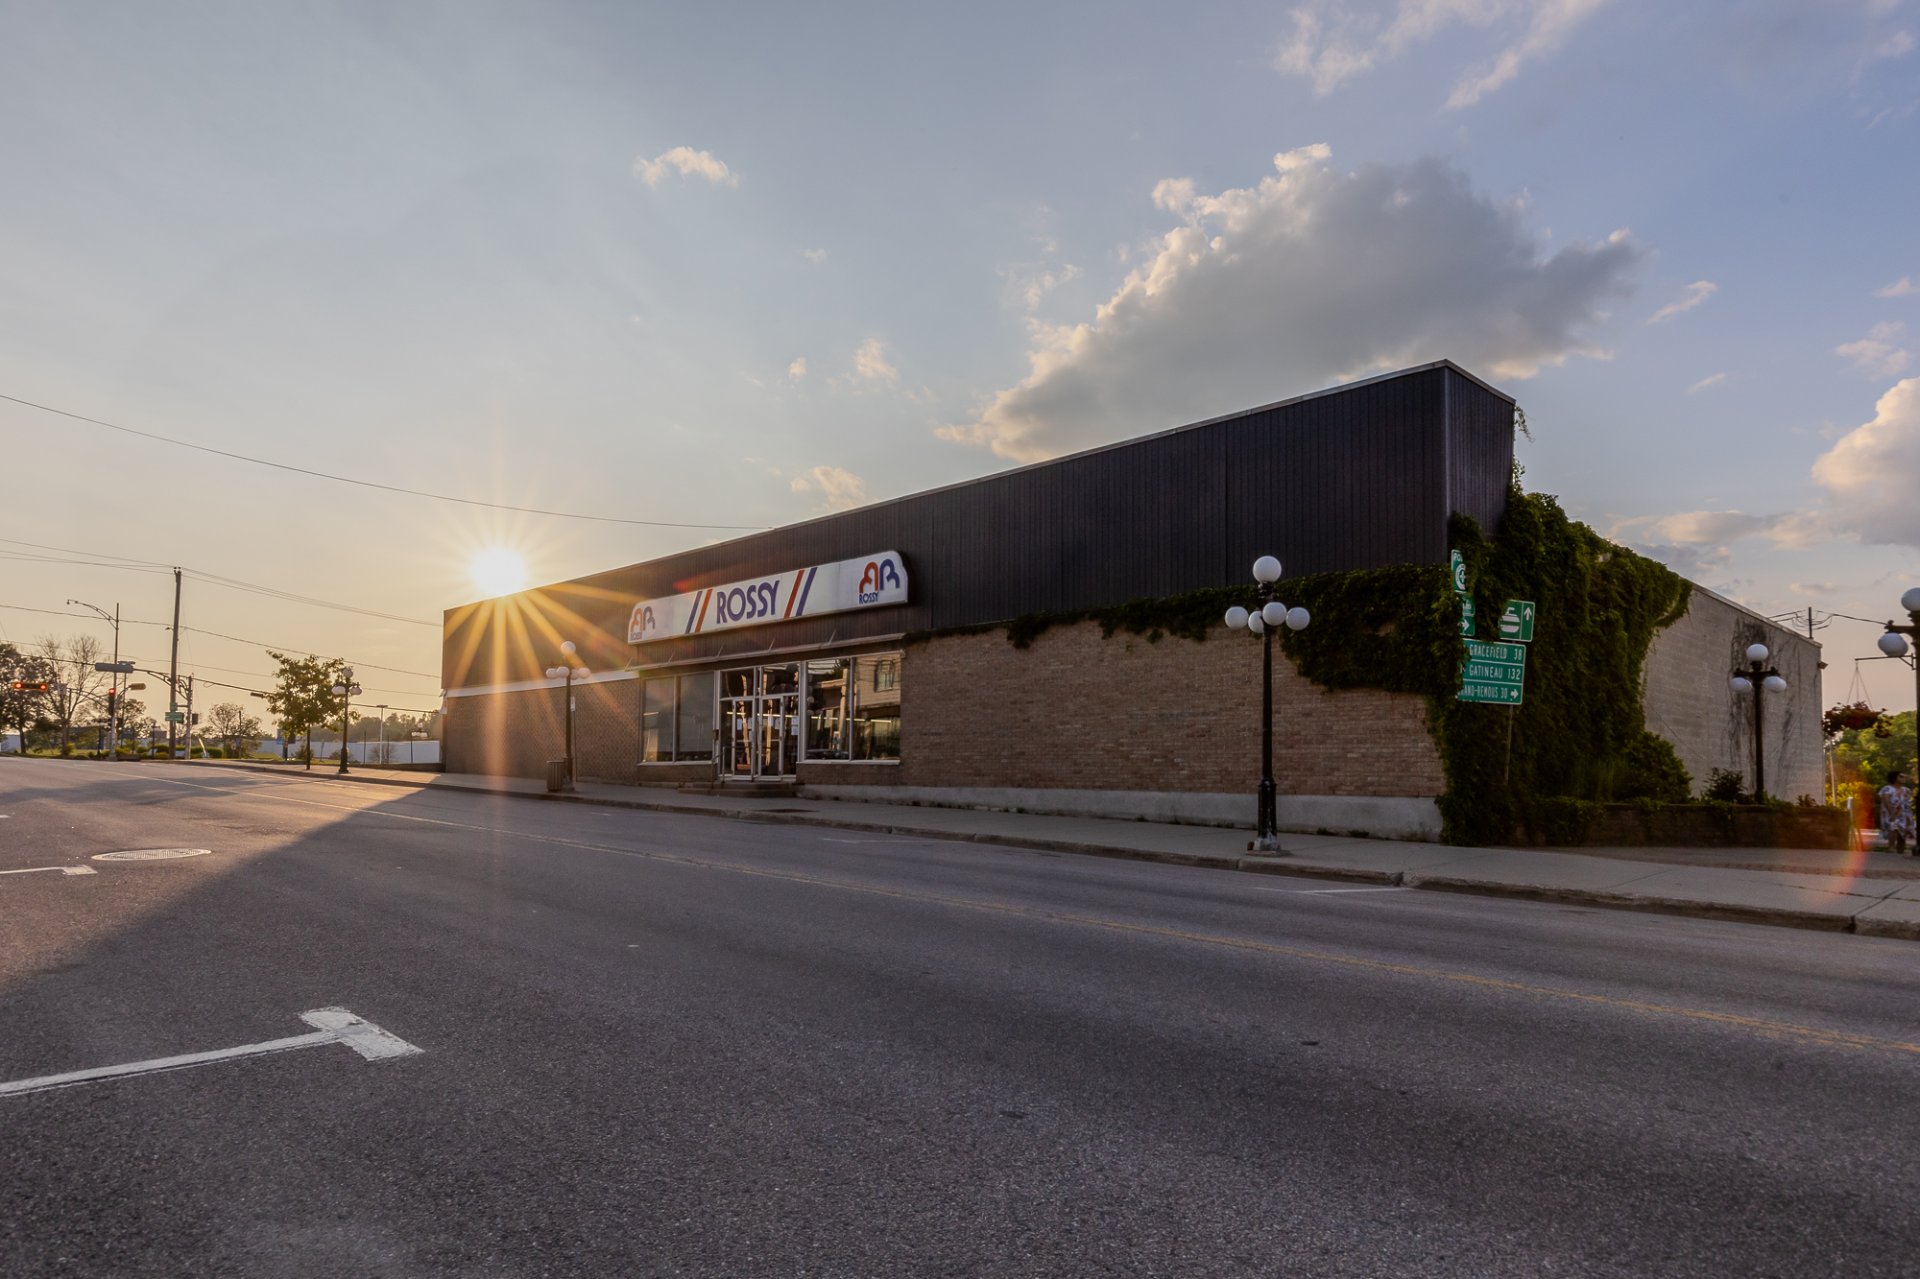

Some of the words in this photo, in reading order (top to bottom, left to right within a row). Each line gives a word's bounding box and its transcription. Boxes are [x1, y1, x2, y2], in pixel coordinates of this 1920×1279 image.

[716, 580, 780, 624] ROSSY
[858, 592, 879, 604] ROSSY
[1469, 644, 1507, 659] GRACEFIELD
[1469, 664, 1504, 679] GATINEAU
[1508, 668, 1520, 680] 132
